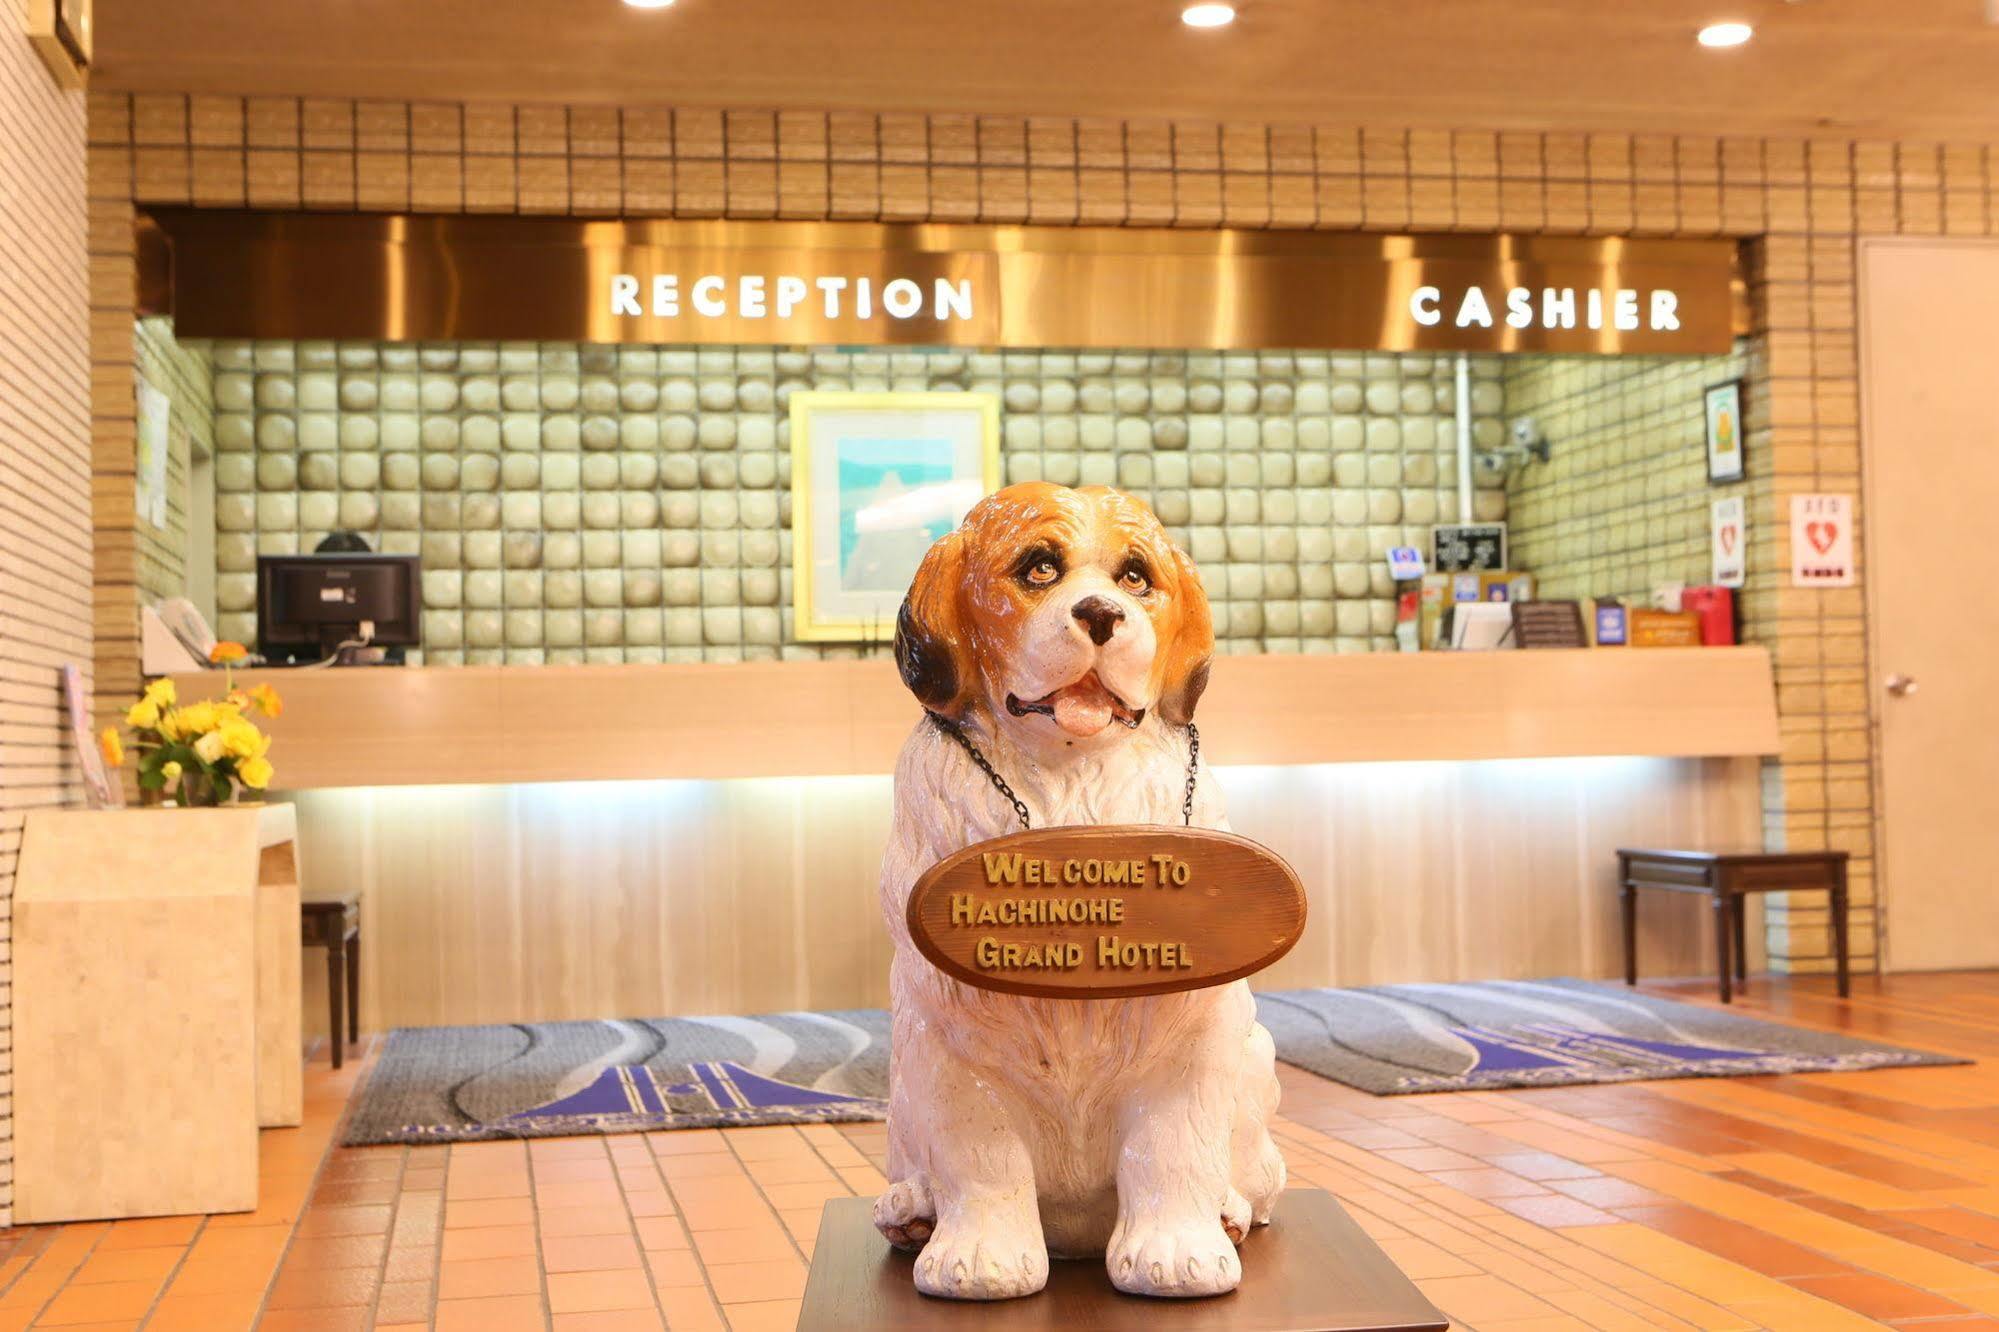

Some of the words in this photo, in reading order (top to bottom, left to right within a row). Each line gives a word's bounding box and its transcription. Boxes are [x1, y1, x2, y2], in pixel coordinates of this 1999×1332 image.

[610, 273, 973, 320] RECEPTION
[1409, 286, 1681, 331] CASHIER
[982, 852, 1146, 885] WELCOME
[1151, 854, 1192, 887] TO
[951, 892, 1125, 926] HACHINOHE
[976, 936, 1085, 969] GRAND
[1098, 935, 1194, 968] HOTEL
